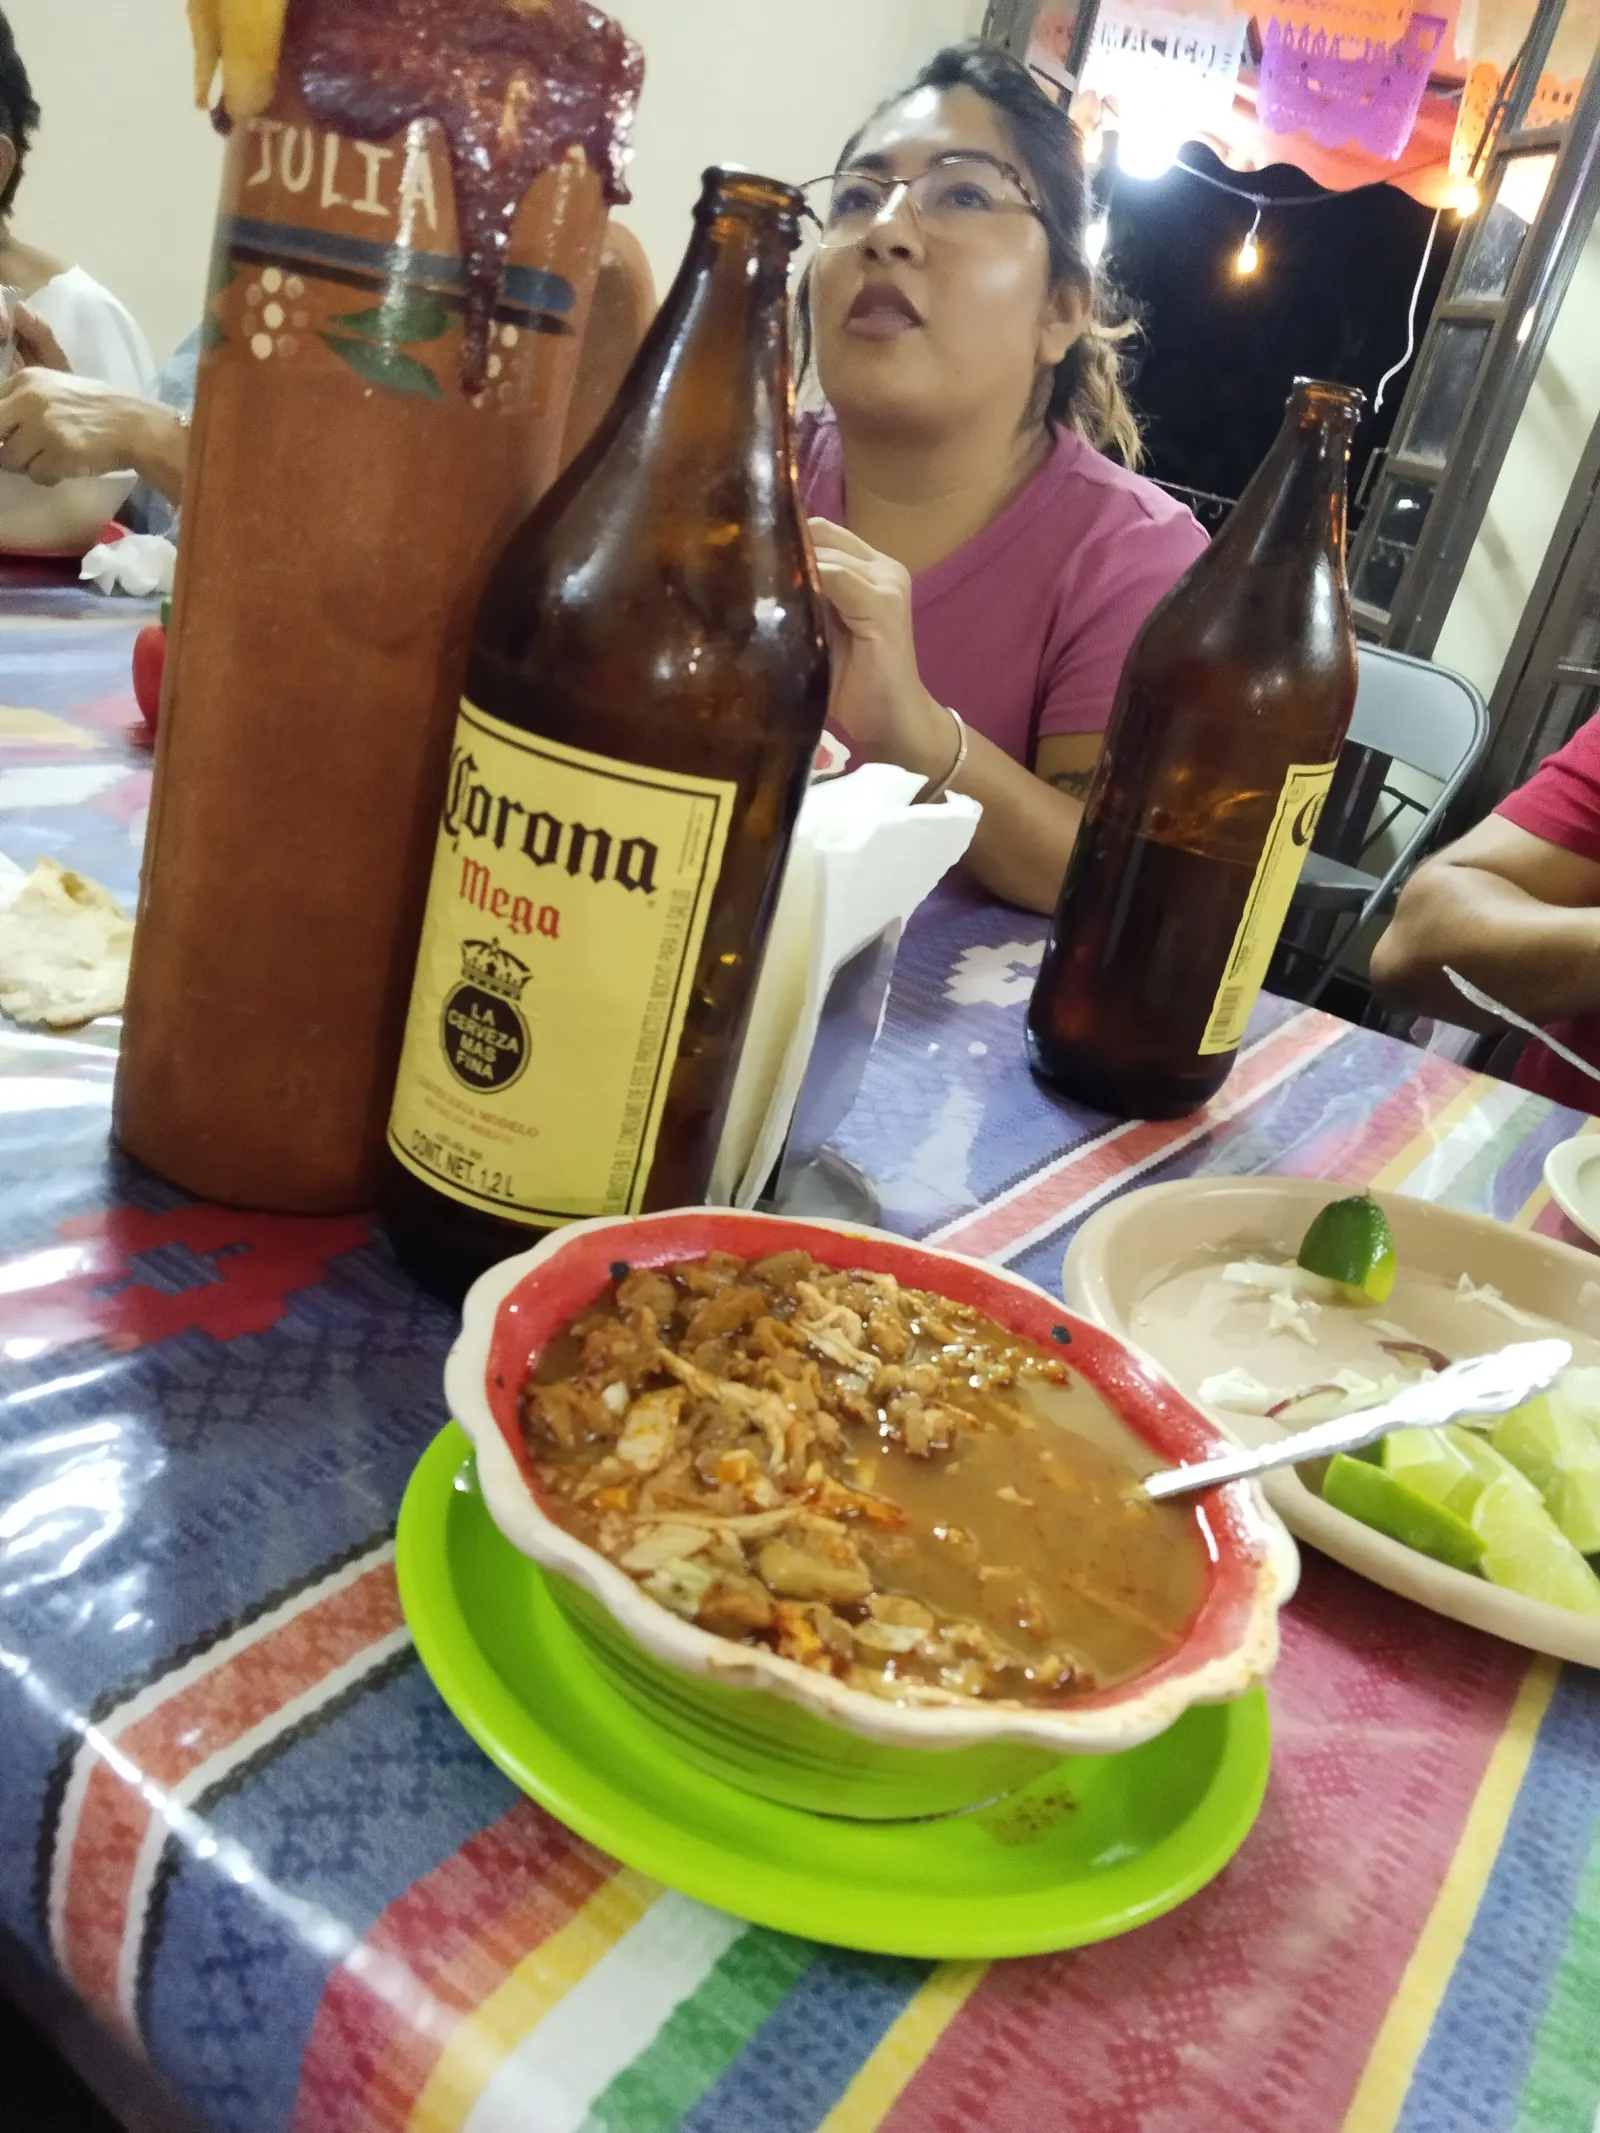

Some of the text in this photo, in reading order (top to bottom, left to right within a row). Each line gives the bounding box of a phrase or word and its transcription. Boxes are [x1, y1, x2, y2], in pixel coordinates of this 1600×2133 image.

[247, 116, 438, 232] JULIA
[445, 746, 658, 895] Corona
[460, 856, 560, 940] Mega
[447, 1009, 520, 1056] CERVEZA
[471, 1002, 496, 1027] LA
[456, 1050, 495, 1081] FINA
